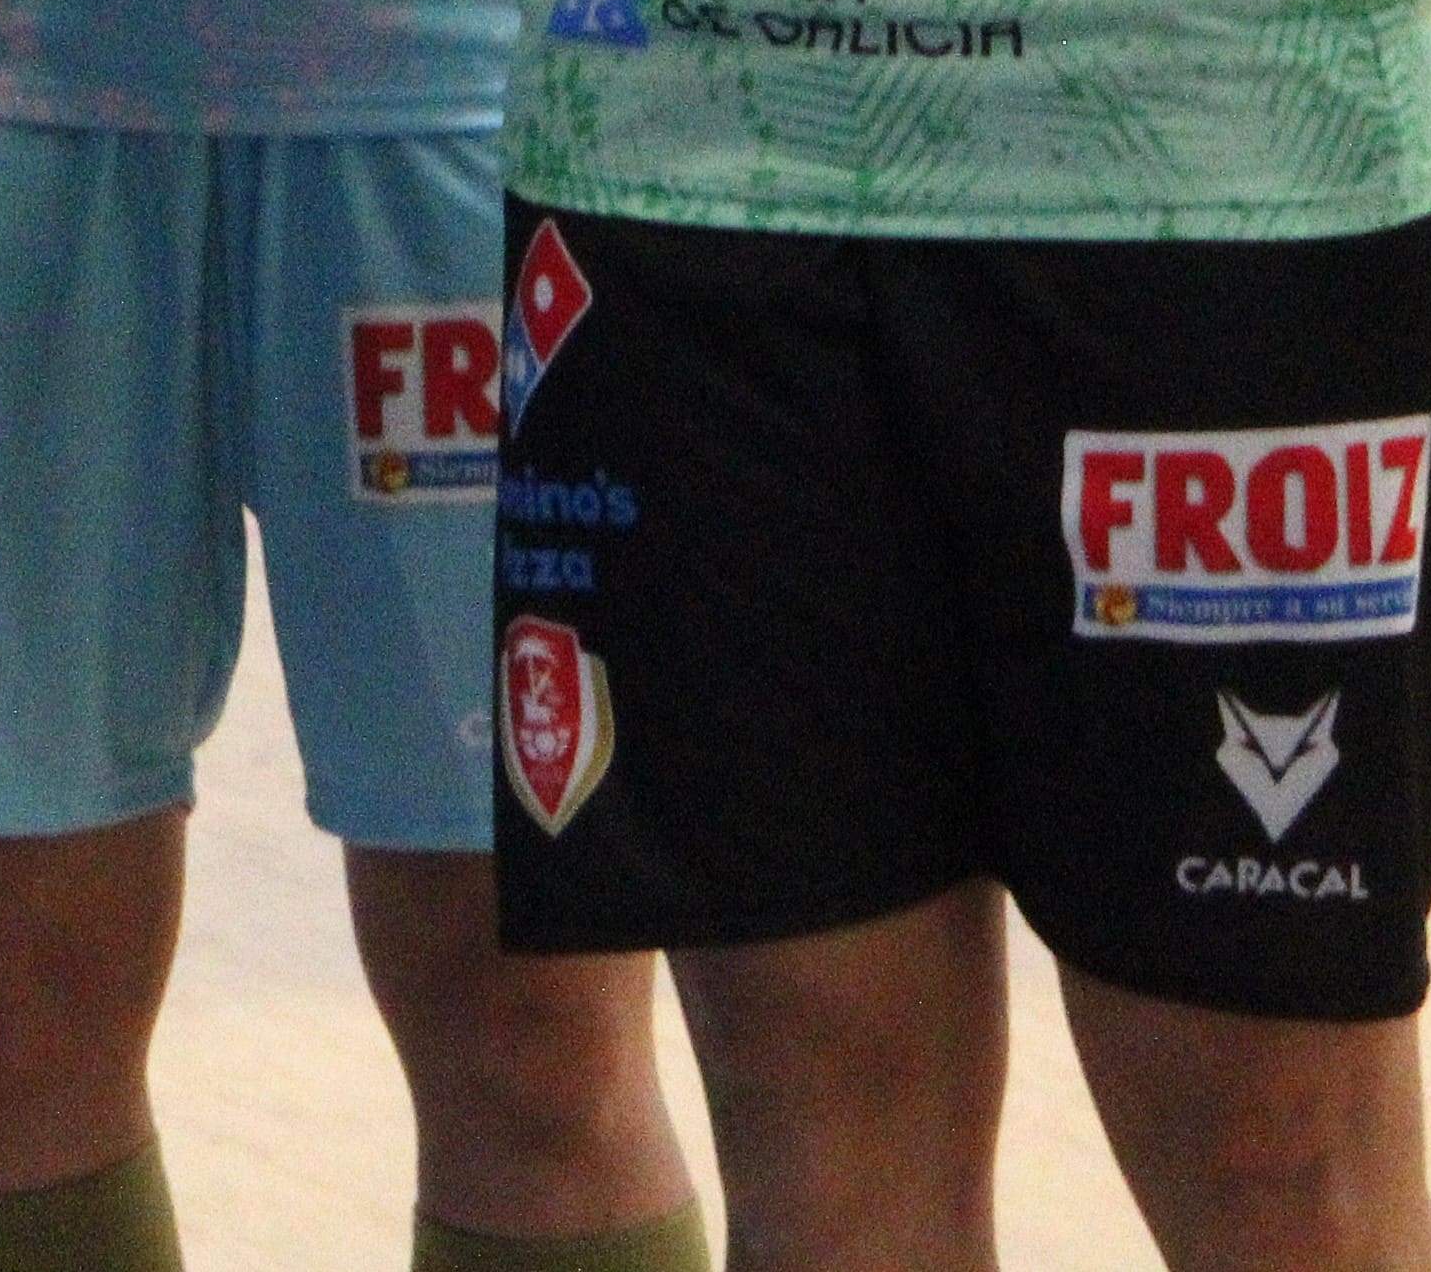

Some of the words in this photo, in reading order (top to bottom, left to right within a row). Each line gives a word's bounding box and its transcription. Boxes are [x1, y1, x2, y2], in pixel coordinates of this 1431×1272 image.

[754, 11, 1025, 59] GALICIA
[1081, 436, 1425, 575] FROIZ
[1175, 855, 1369, 903] CARACAL
